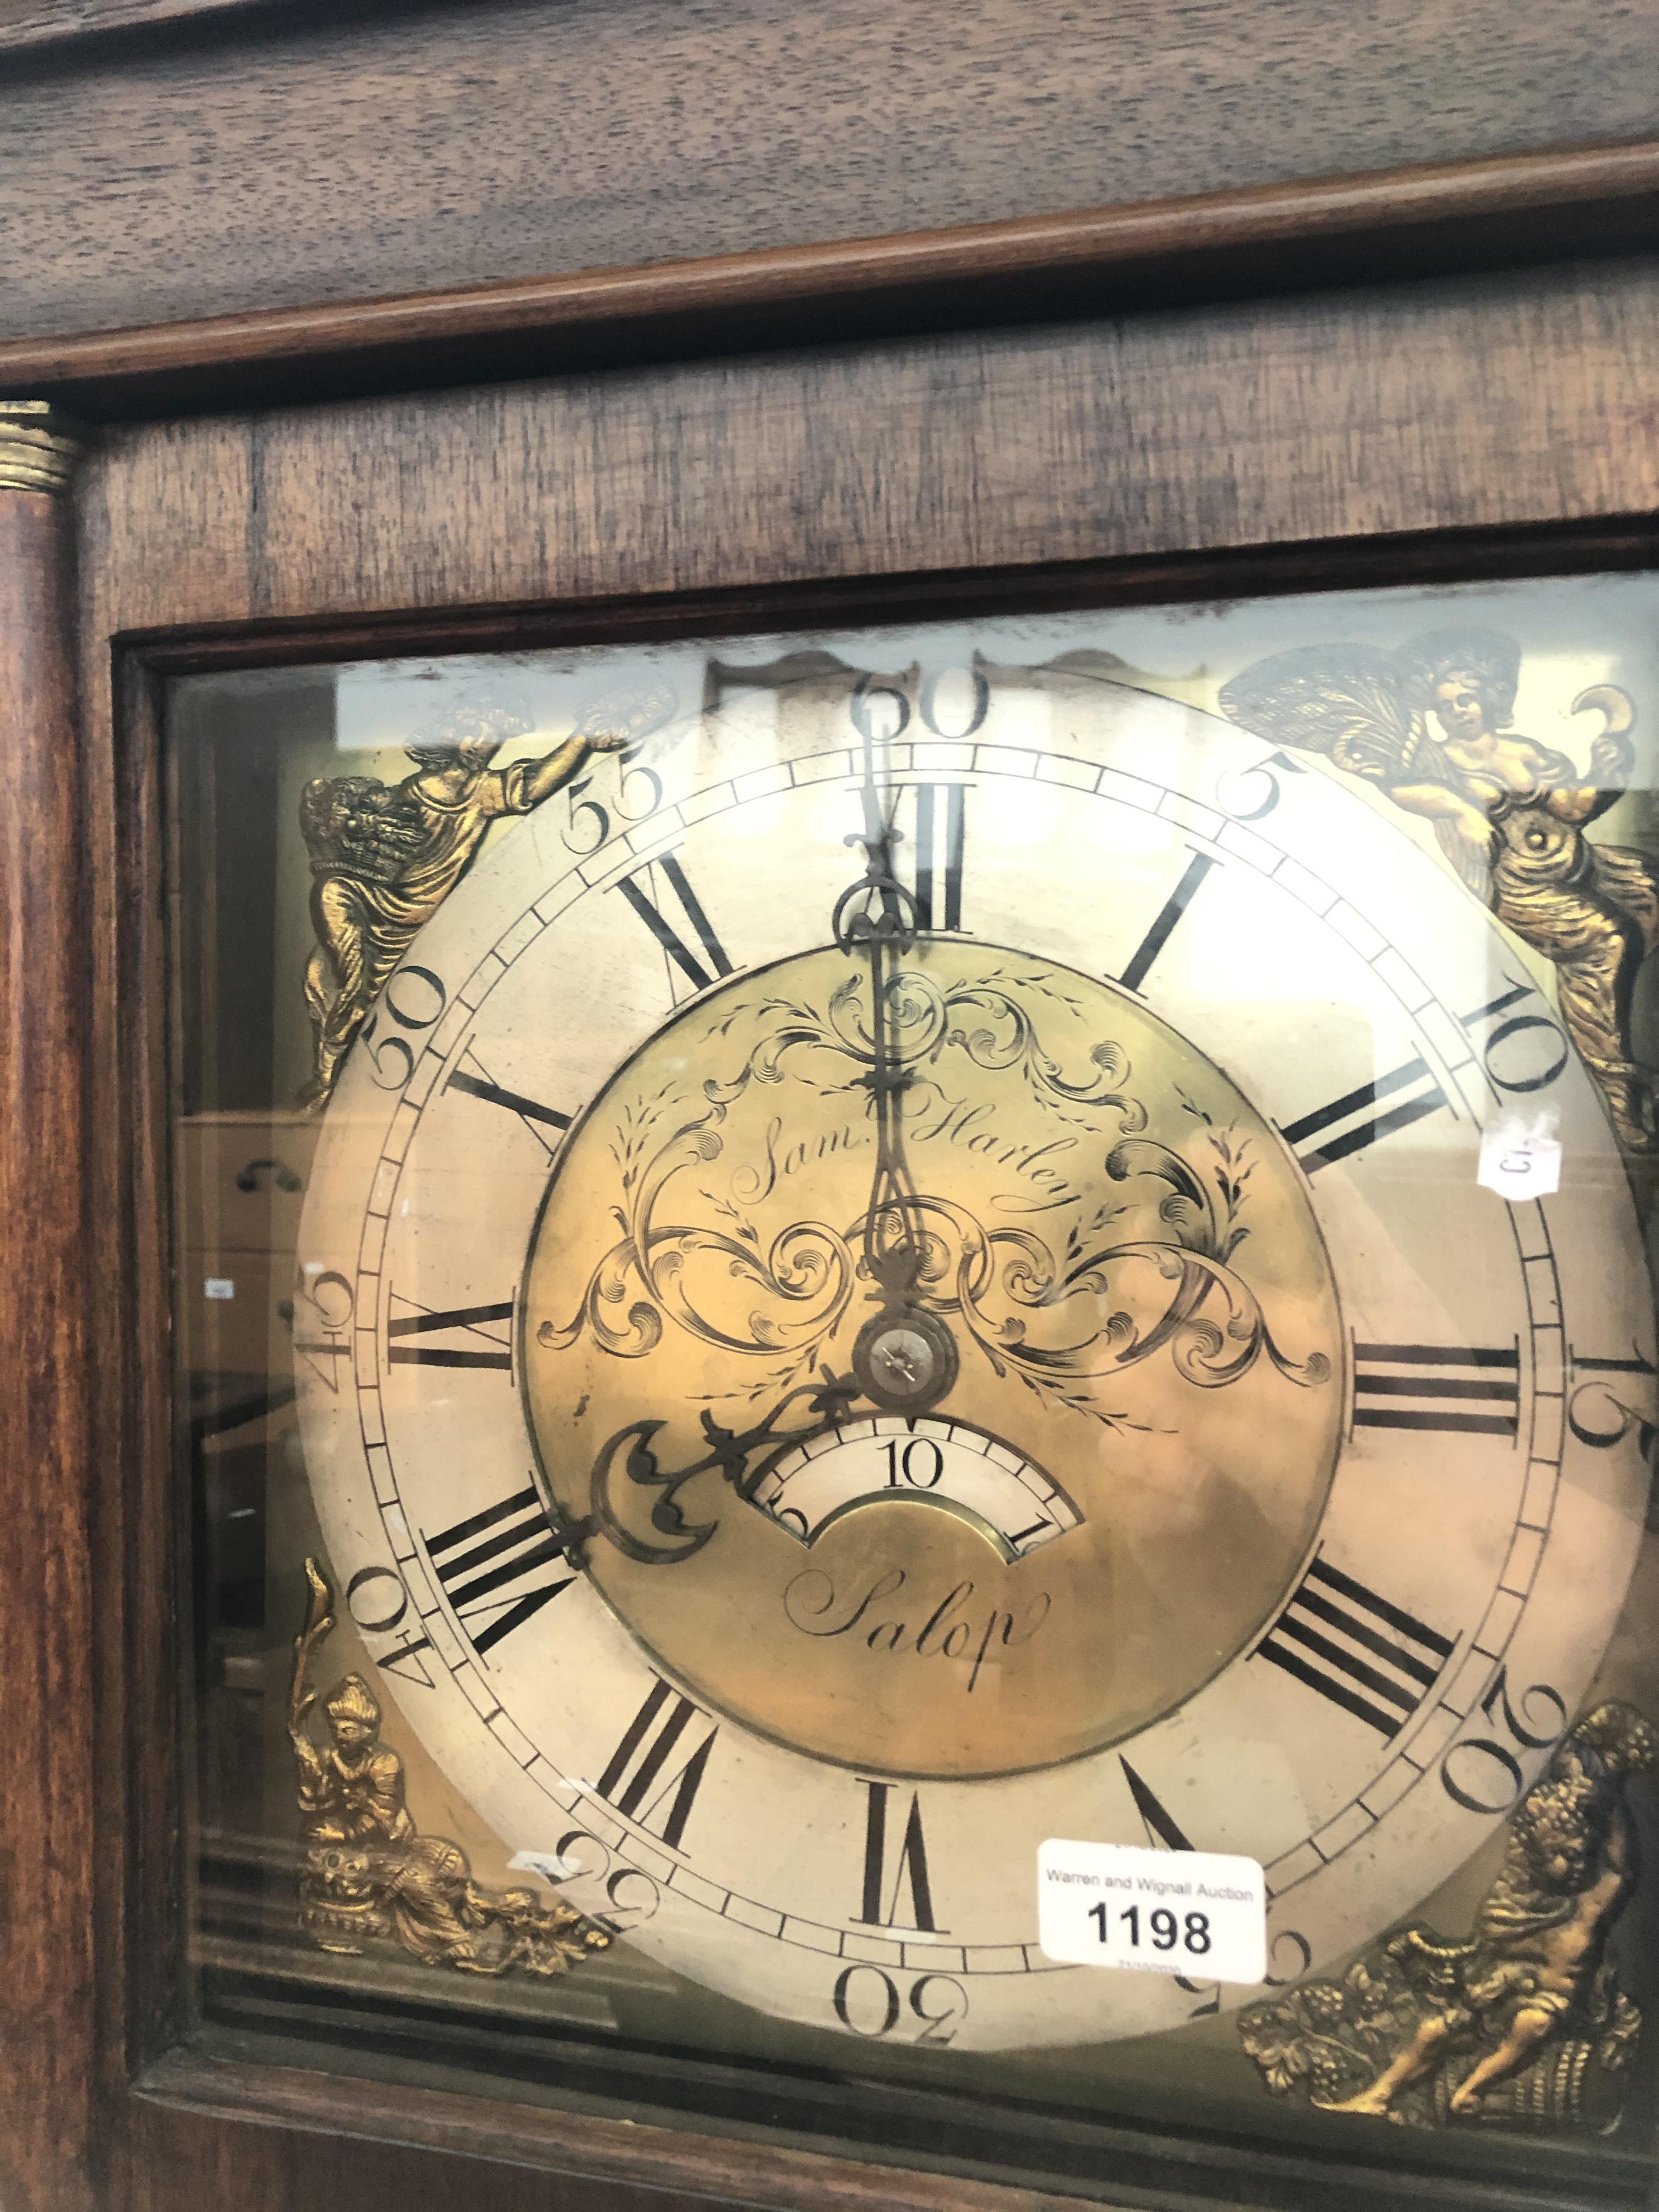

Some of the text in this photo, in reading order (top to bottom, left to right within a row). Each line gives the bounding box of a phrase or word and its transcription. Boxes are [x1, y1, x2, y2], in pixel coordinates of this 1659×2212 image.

[560, 742, 663, 855] 55
[1215, 752, 1309, 821] 5
[602, 842, 747, 1015] XI
[362, 964, 447, 1091] 50
[1453, 970, 1568, 1093] 10
[440, 1033, 584, 1167] X
[295, 1264, 354, 1393] 45
[876, 1438, 944, 1489] 10
[347, 1566, 436, 1689] 40
[782, 1569, 1051, 1692] Salop
[1441, 1664, 1567, 1814] 20
[529, 1830, 661, 1934] 35
[1046, 1868, 1255, 1902] Warren and Wignall Auction
[1088, 1900, 1212, 1955] 1198
[833, 1964, 969, 2045] 30
